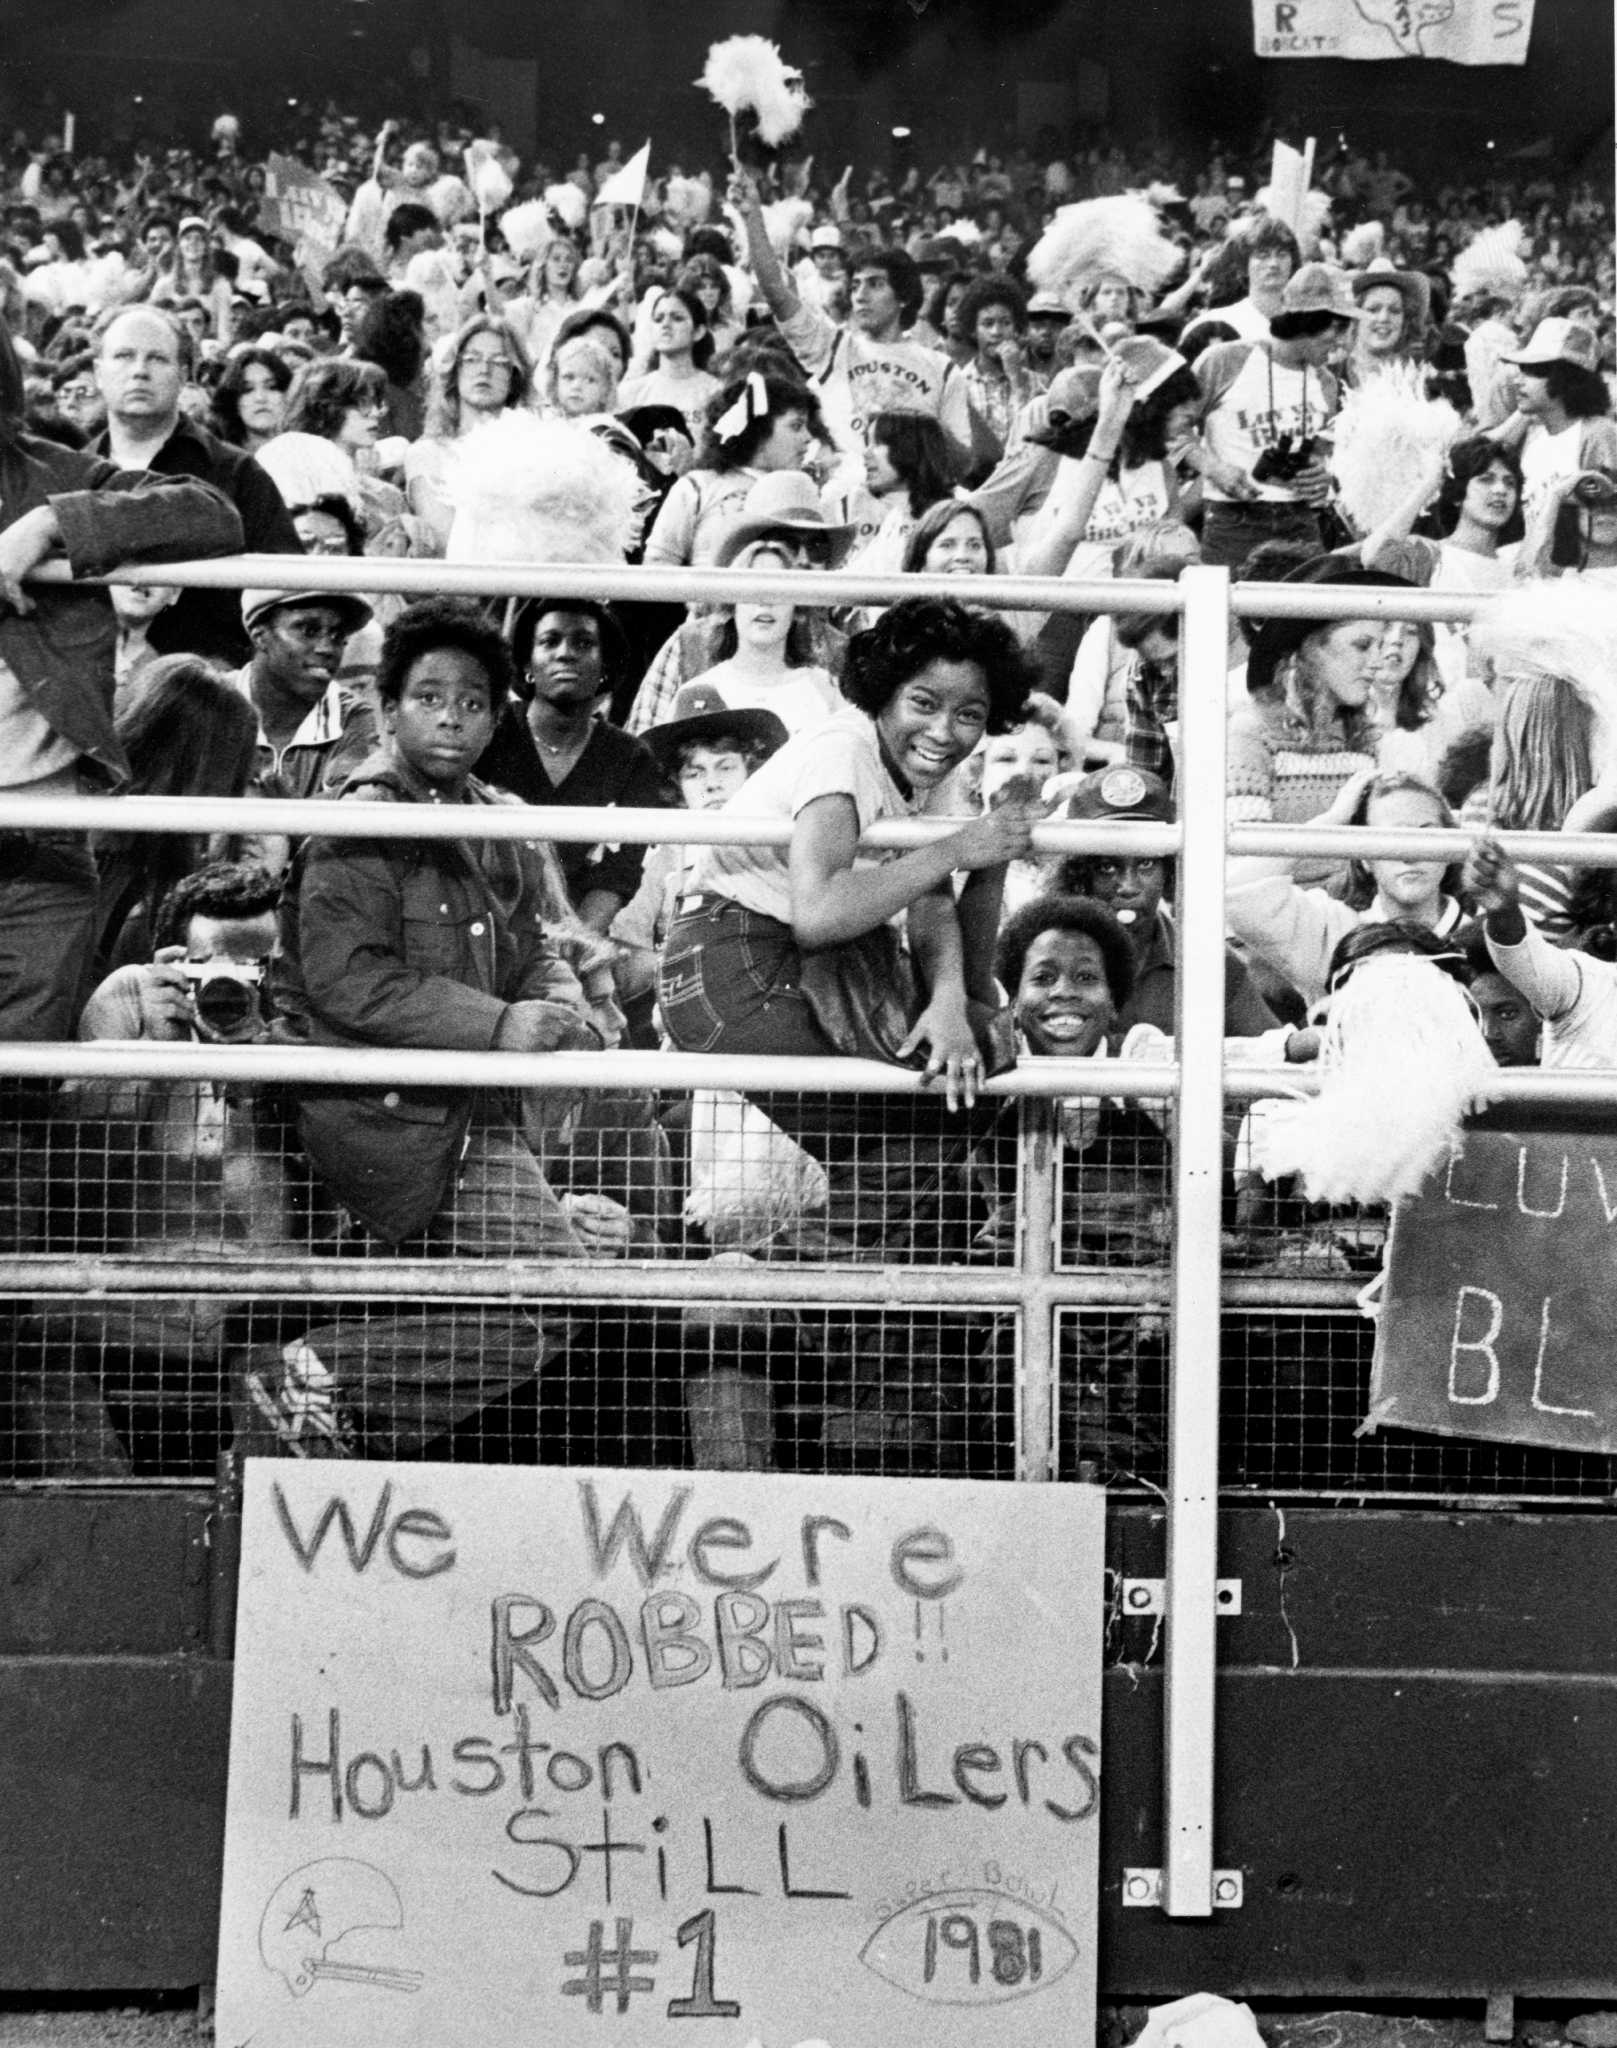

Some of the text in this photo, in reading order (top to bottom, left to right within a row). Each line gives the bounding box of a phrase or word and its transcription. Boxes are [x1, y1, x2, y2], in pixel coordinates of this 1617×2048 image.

[1274, 3, 1298, 33] R
[271, 1478, 965, 1601] We Were
[288, 1706, 642, 1824] Houston
[561, 1906, 742, 2019] #1
[923, 1913, 1043, 1987] 1981
